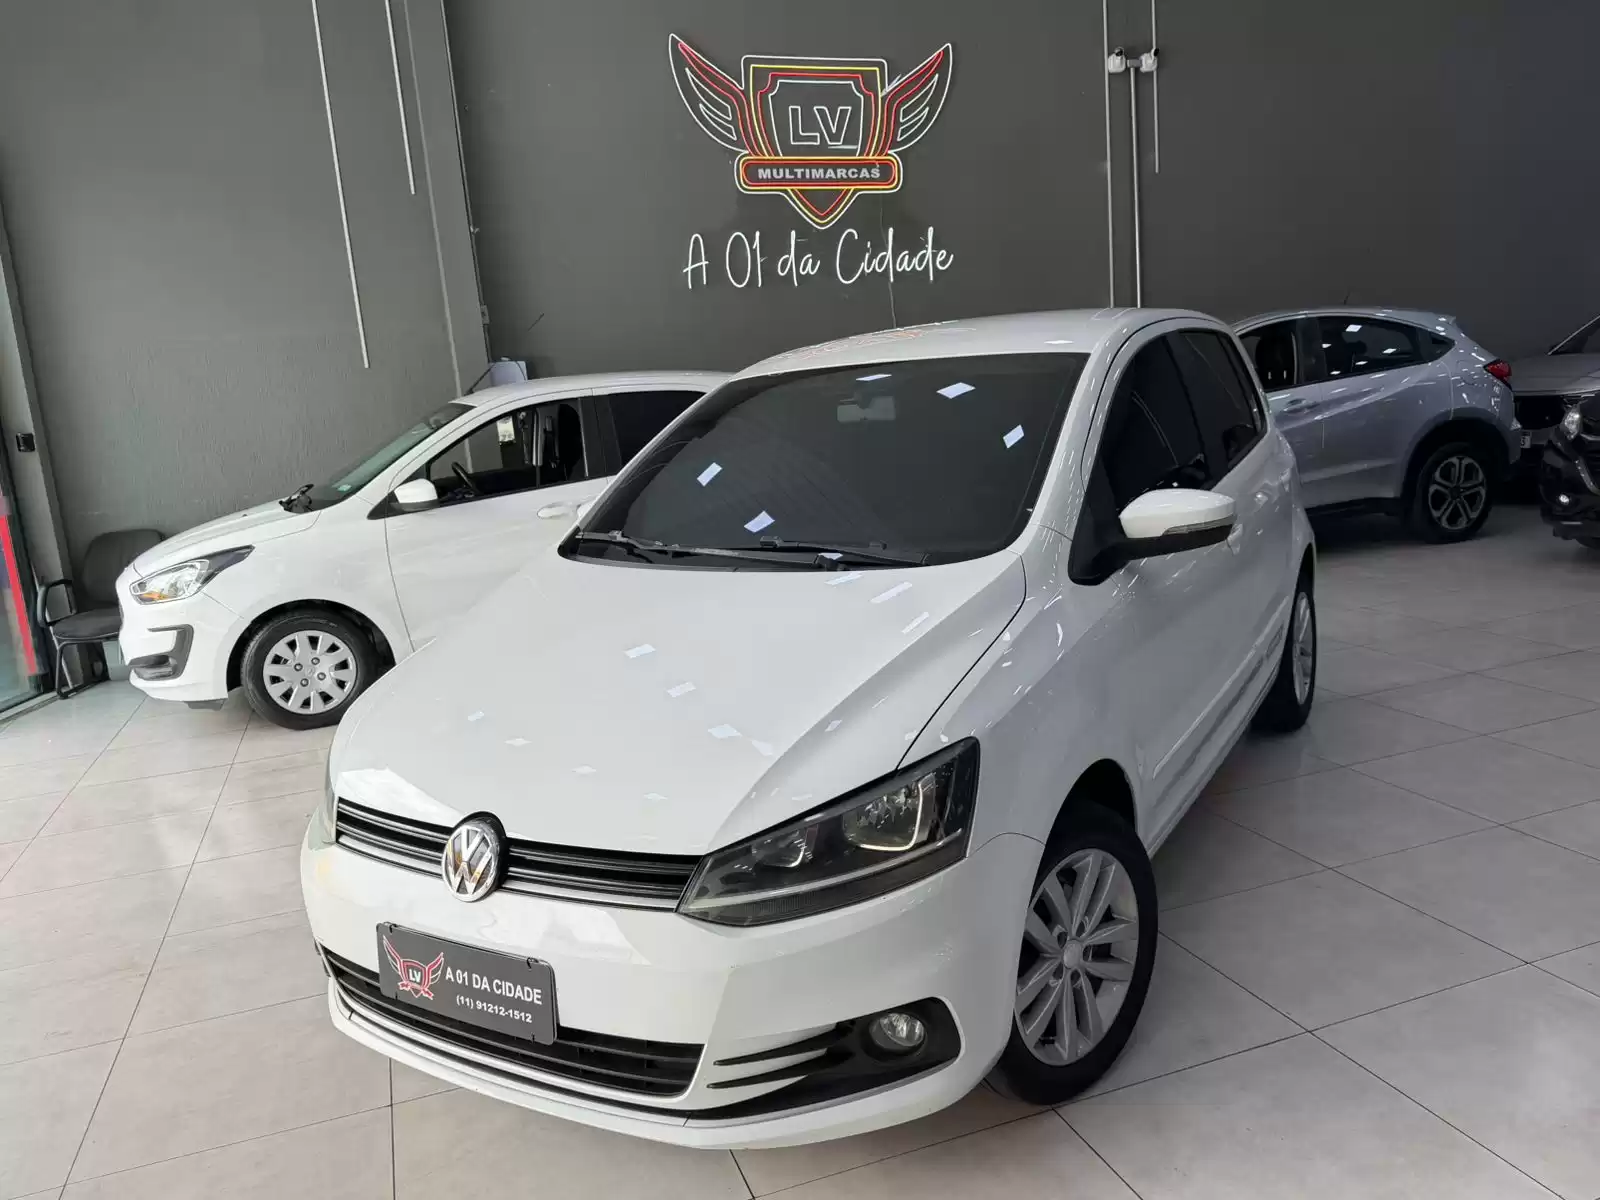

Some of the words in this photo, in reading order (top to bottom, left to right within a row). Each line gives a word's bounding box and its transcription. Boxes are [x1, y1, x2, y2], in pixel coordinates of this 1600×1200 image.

[788, 105, 852, 146] LV
[757, 167, 881, 179] MULTIMARCAS
[682, 233, 709, 289] A
[777, 229, 821, 288] da
[835, 226, 954, 285] Cidade
[408, 968, 421, 983] LV
[445, 966, 455, 982] A
[455, 969, 469, 986] 01
[472, 973, 491, 992] DA
[492, 979, 543, 1005] CIDADE
[456, 994, 474, 1009] (11)
[475, 1000, 533, 1023] 91212-1512
